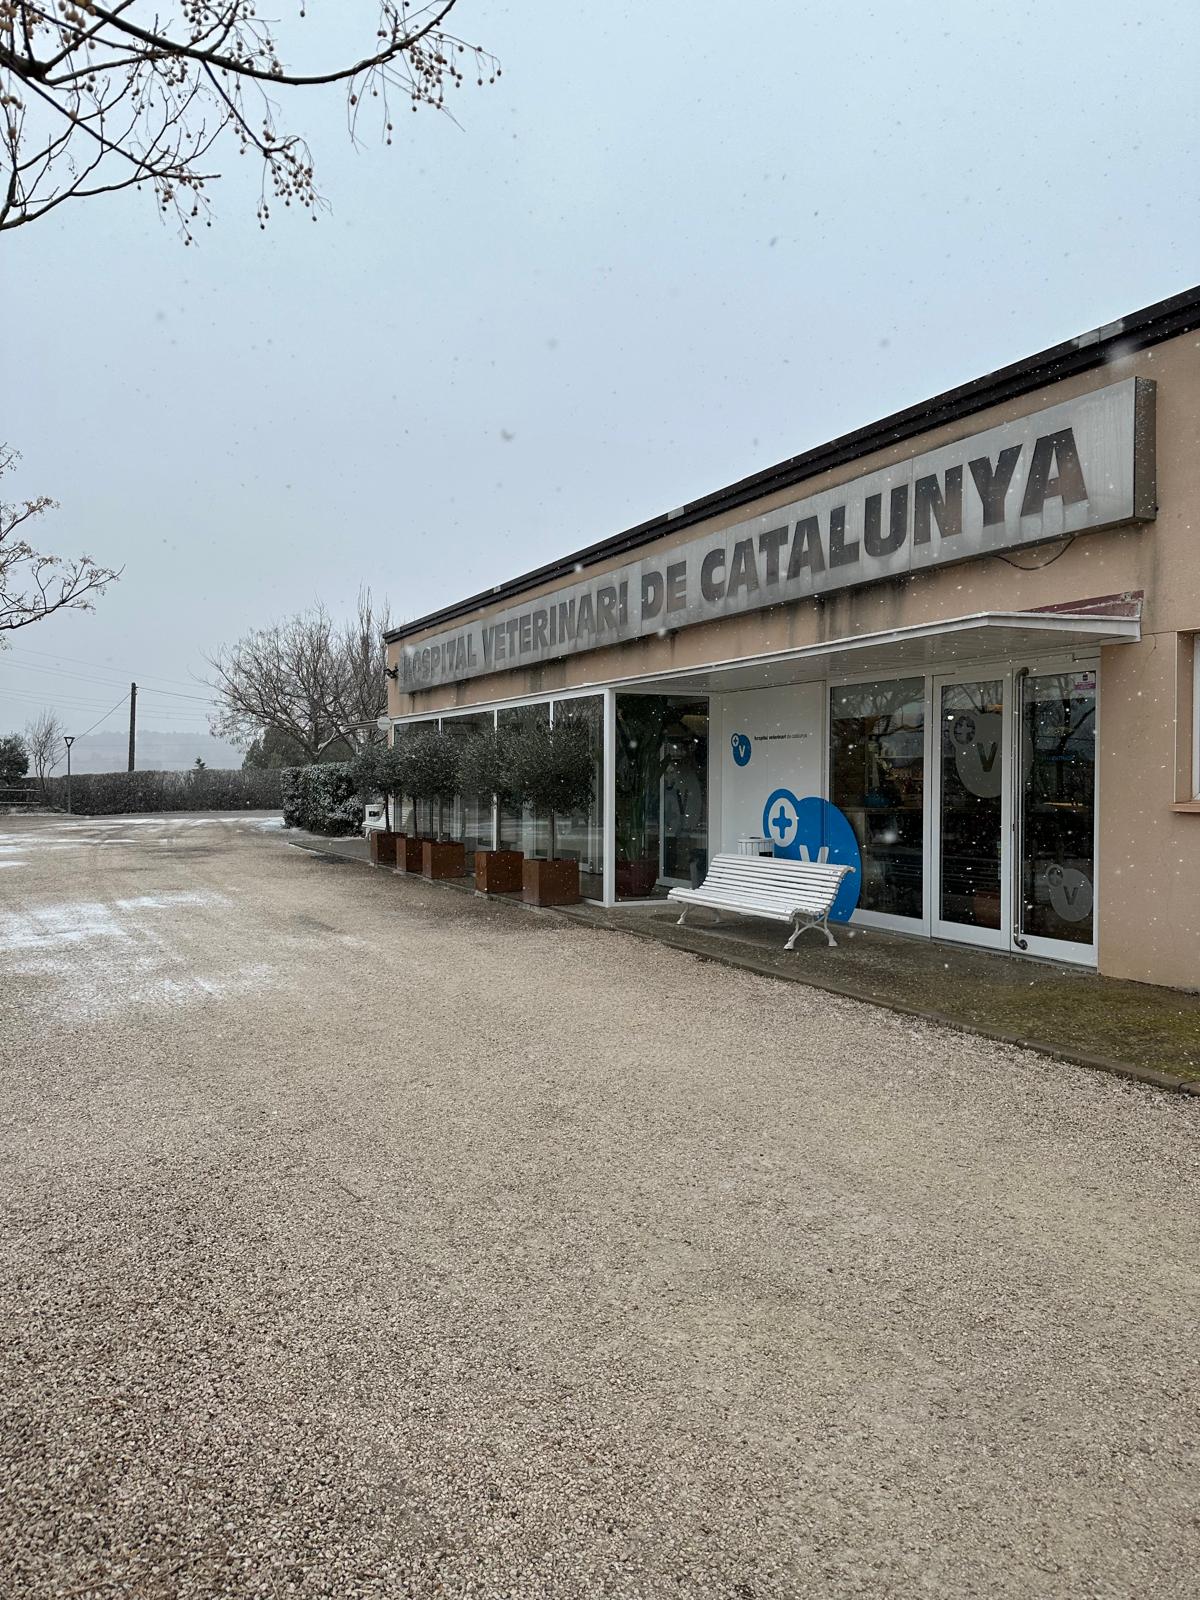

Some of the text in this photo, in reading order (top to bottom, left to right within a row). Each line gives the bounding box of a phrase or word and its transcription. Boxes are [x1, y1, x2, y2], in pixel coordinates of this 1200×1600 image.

[482, 581, 628, 664] VETERINARI
[641, 560, 686, 621] DE
[700, 427, 1089, 602] CATALUNYA
